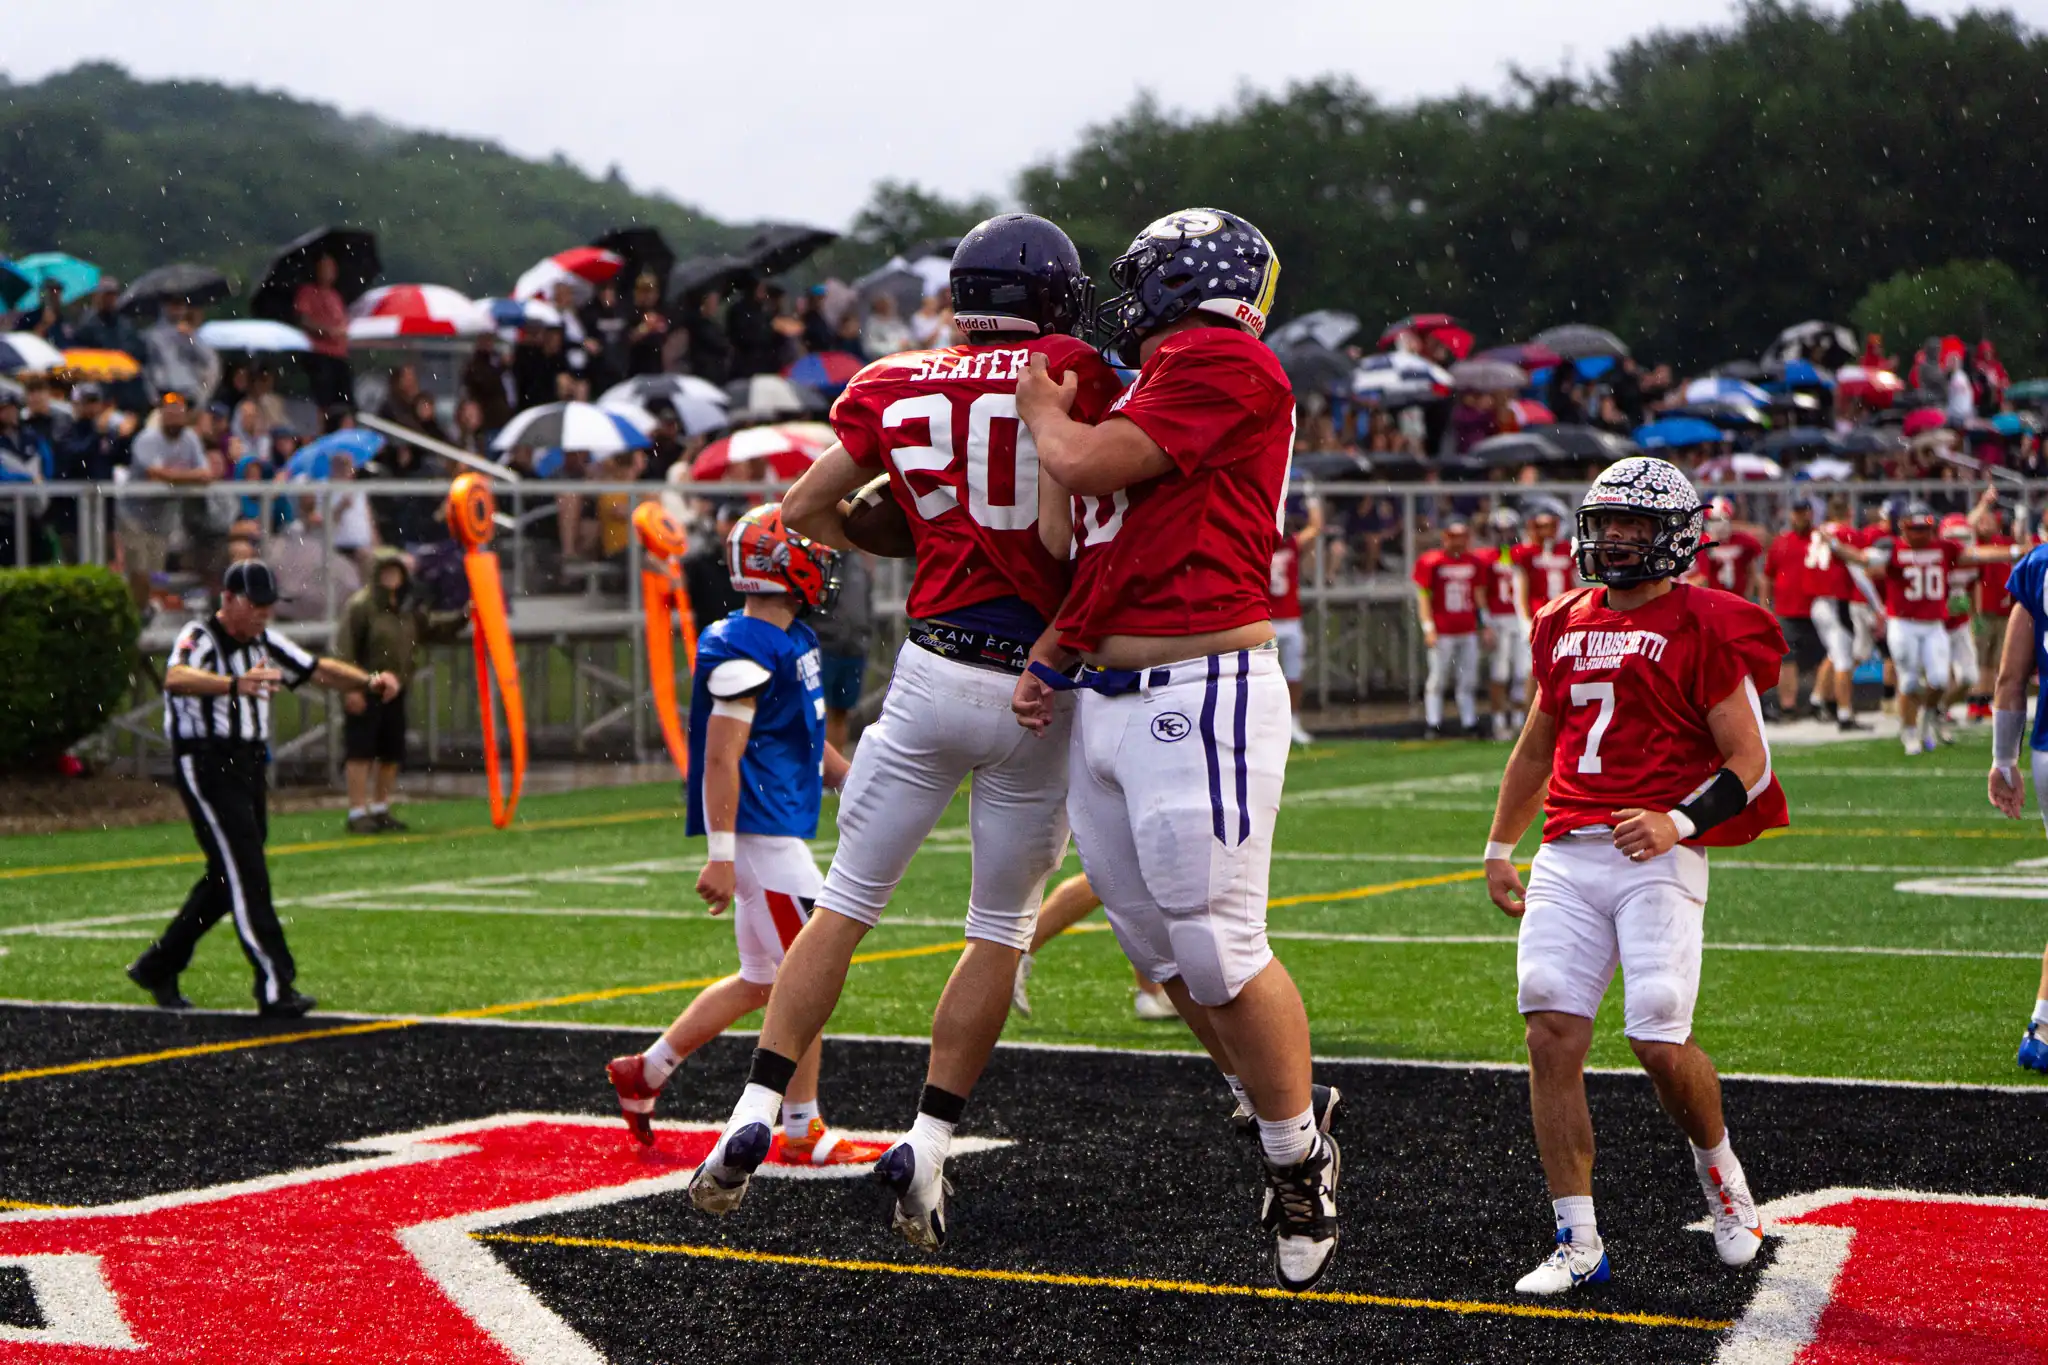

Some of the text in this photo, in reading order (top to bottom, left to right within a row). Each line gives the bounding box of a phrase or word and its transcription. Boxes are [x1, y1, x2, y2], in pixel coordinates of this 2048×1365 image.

[955, 317, 999, 333] Riddell
[909, 348, 1029, 382] SLATER
[882, 393, 1040, 530] 20
[1903, 565, 1945, 601] 30
[1586, 630, 1669, 662] VARISCHETTI
[1156, 718, 1185, 737] KC
[1570, 682, 1616, 774] 7
